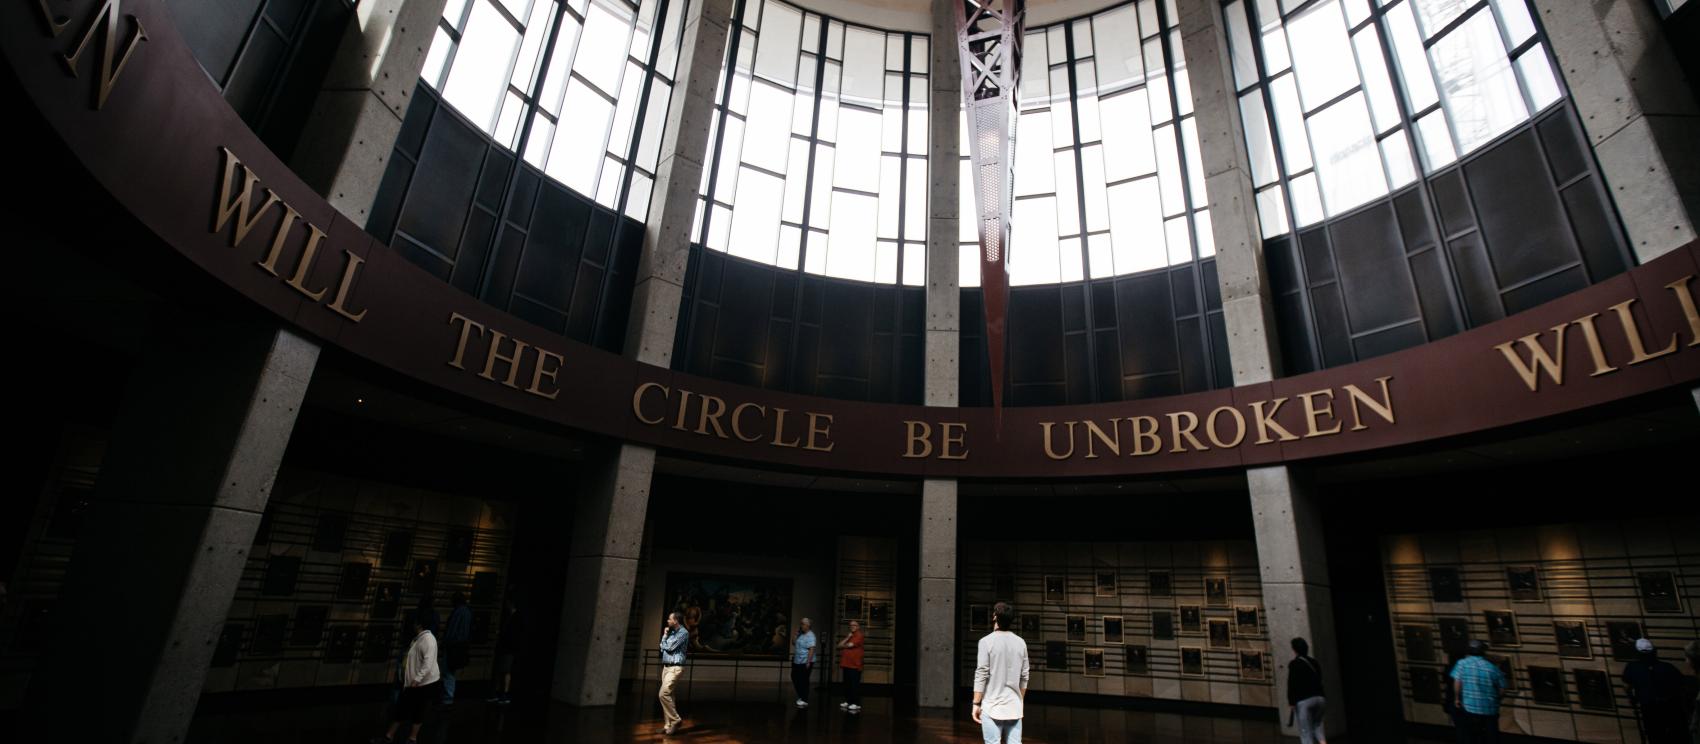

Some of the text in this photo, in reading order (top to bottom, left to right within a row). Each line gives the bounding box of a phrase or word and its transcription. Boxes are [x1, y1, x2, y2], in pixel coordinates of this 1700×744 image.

[211, 147, 368, 322] WILL
[447, 311, 565, 400] THE
[632, 382, 835, 452] CIRCLE
[902, 420, 969, 460] BE
[1039, 376, 1394, 460] UNBROKEN
